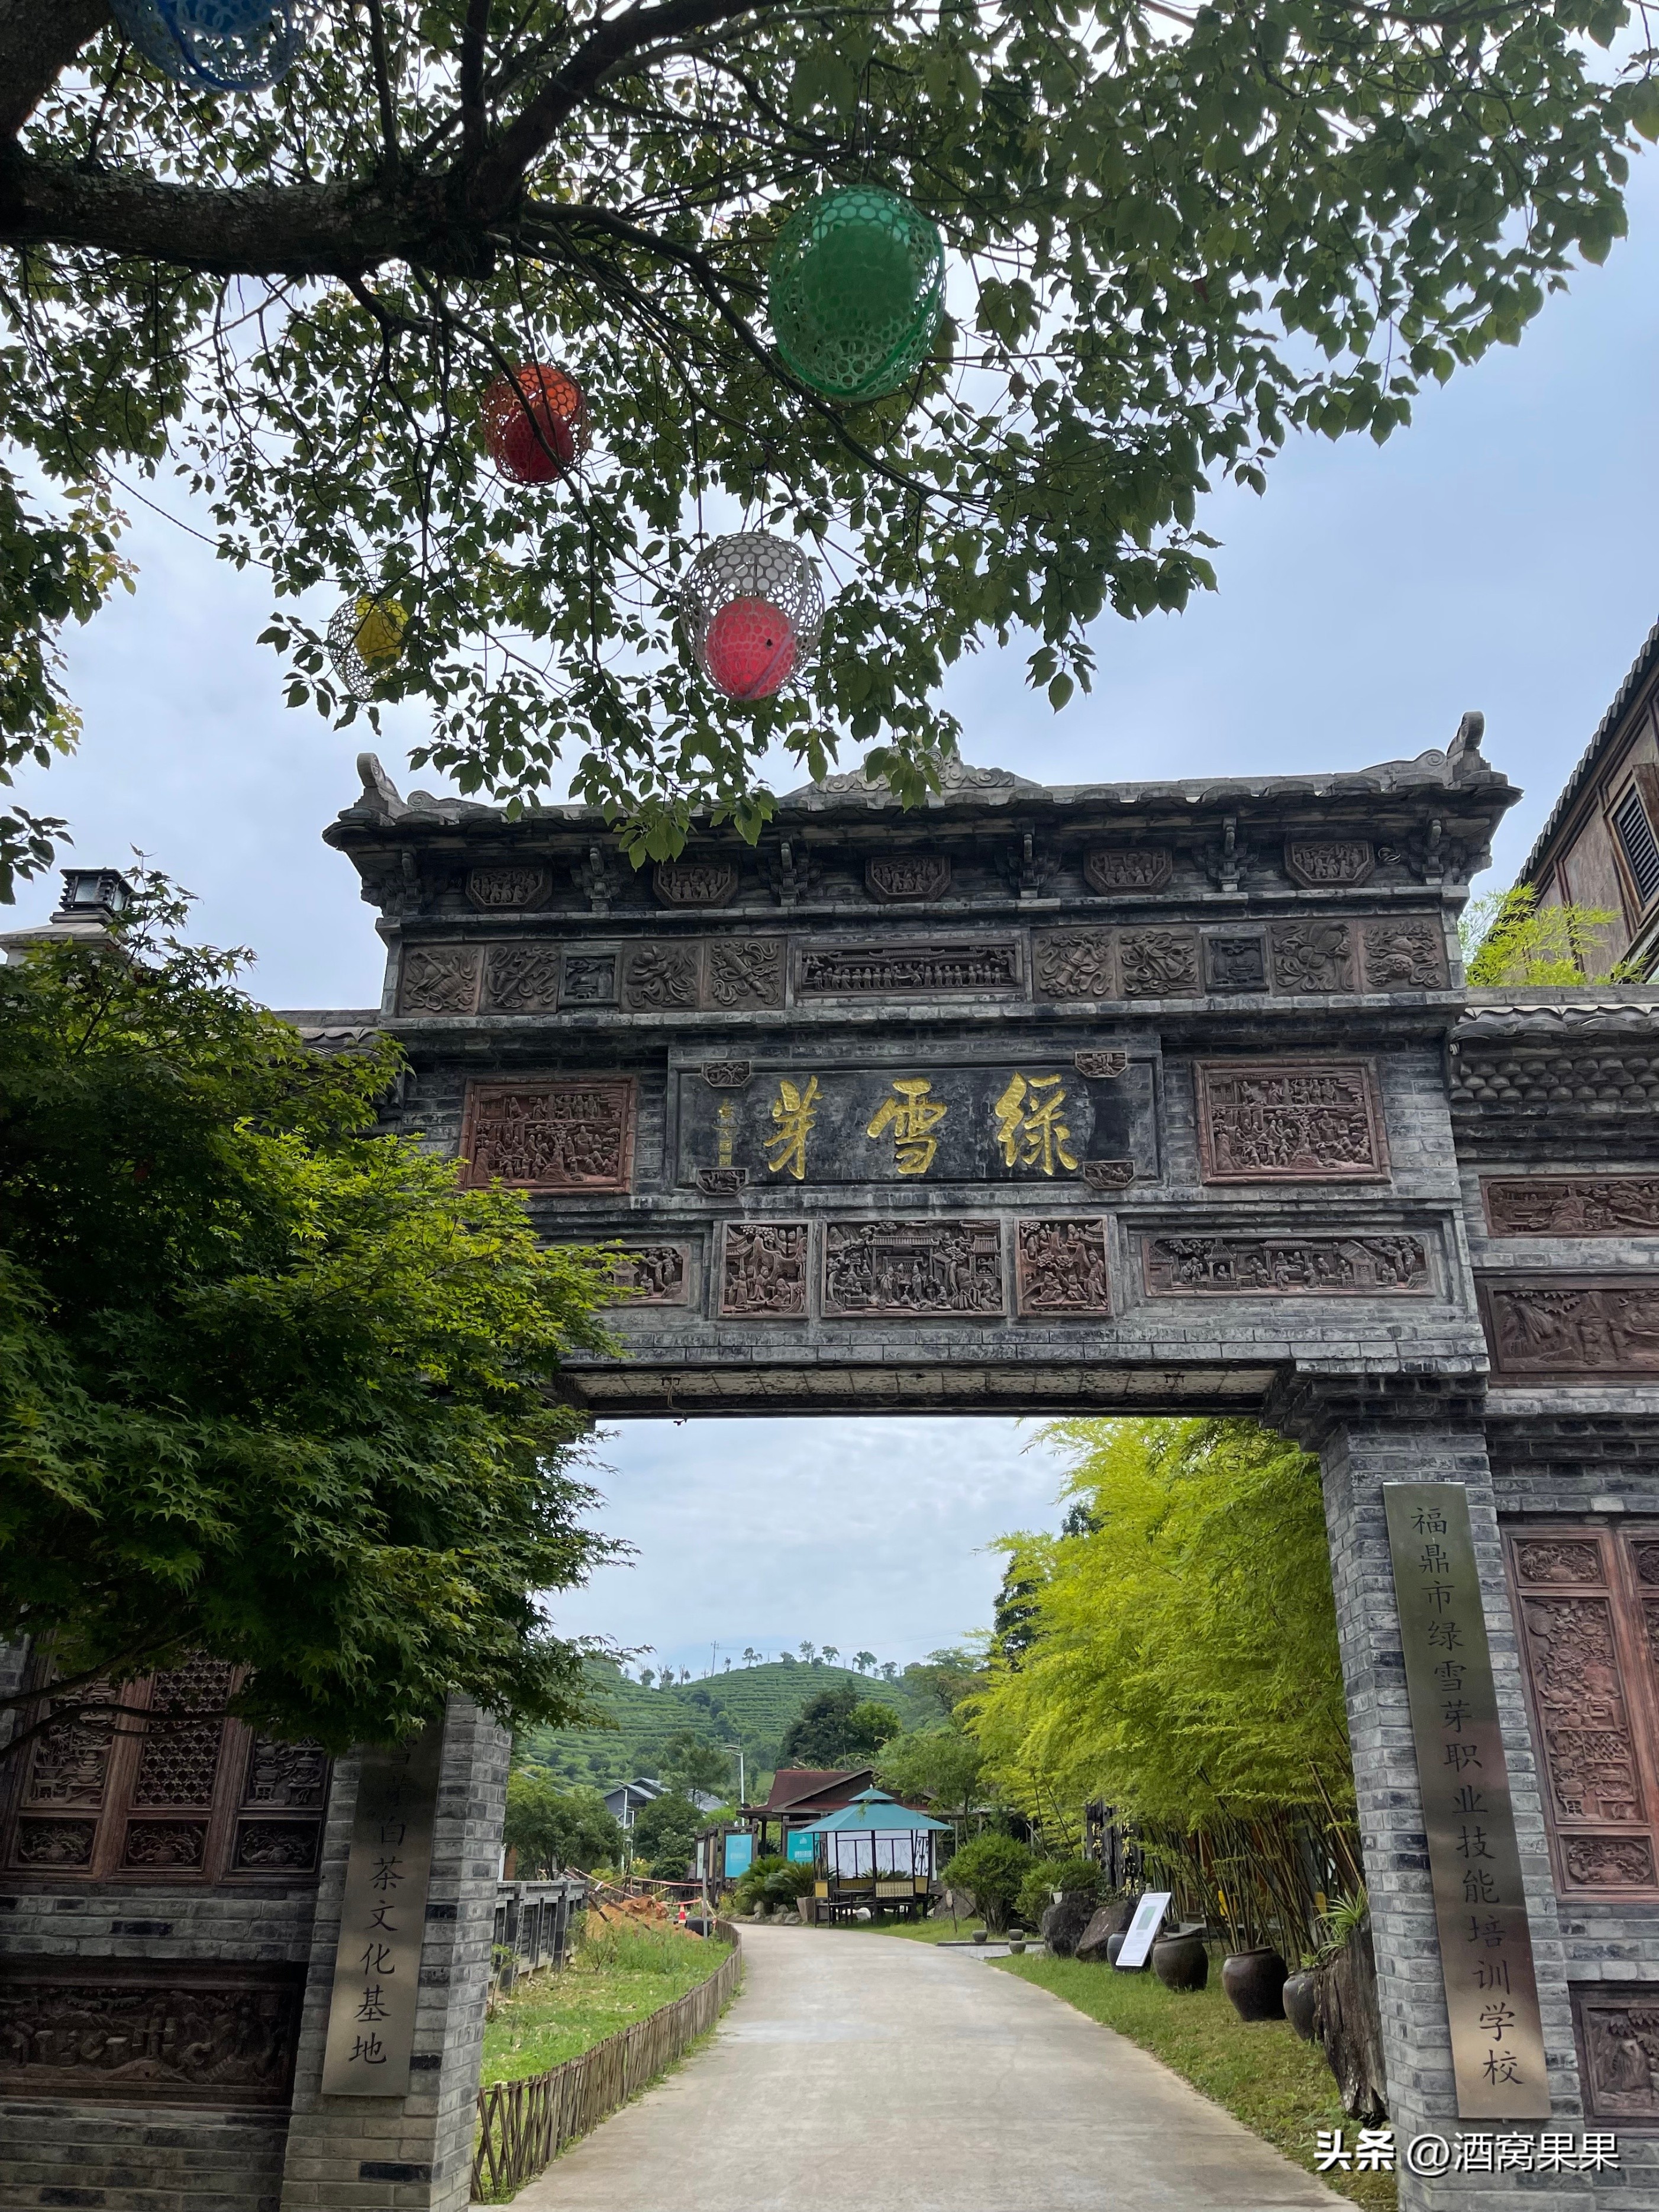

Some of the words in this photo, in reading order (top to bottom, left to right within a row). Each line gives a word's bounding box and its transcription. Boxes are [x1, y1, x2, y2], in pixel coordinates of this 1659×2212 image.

[1411, 1507, 1525, 2086] 福鼎市绿雪芽职业技能培训学校
